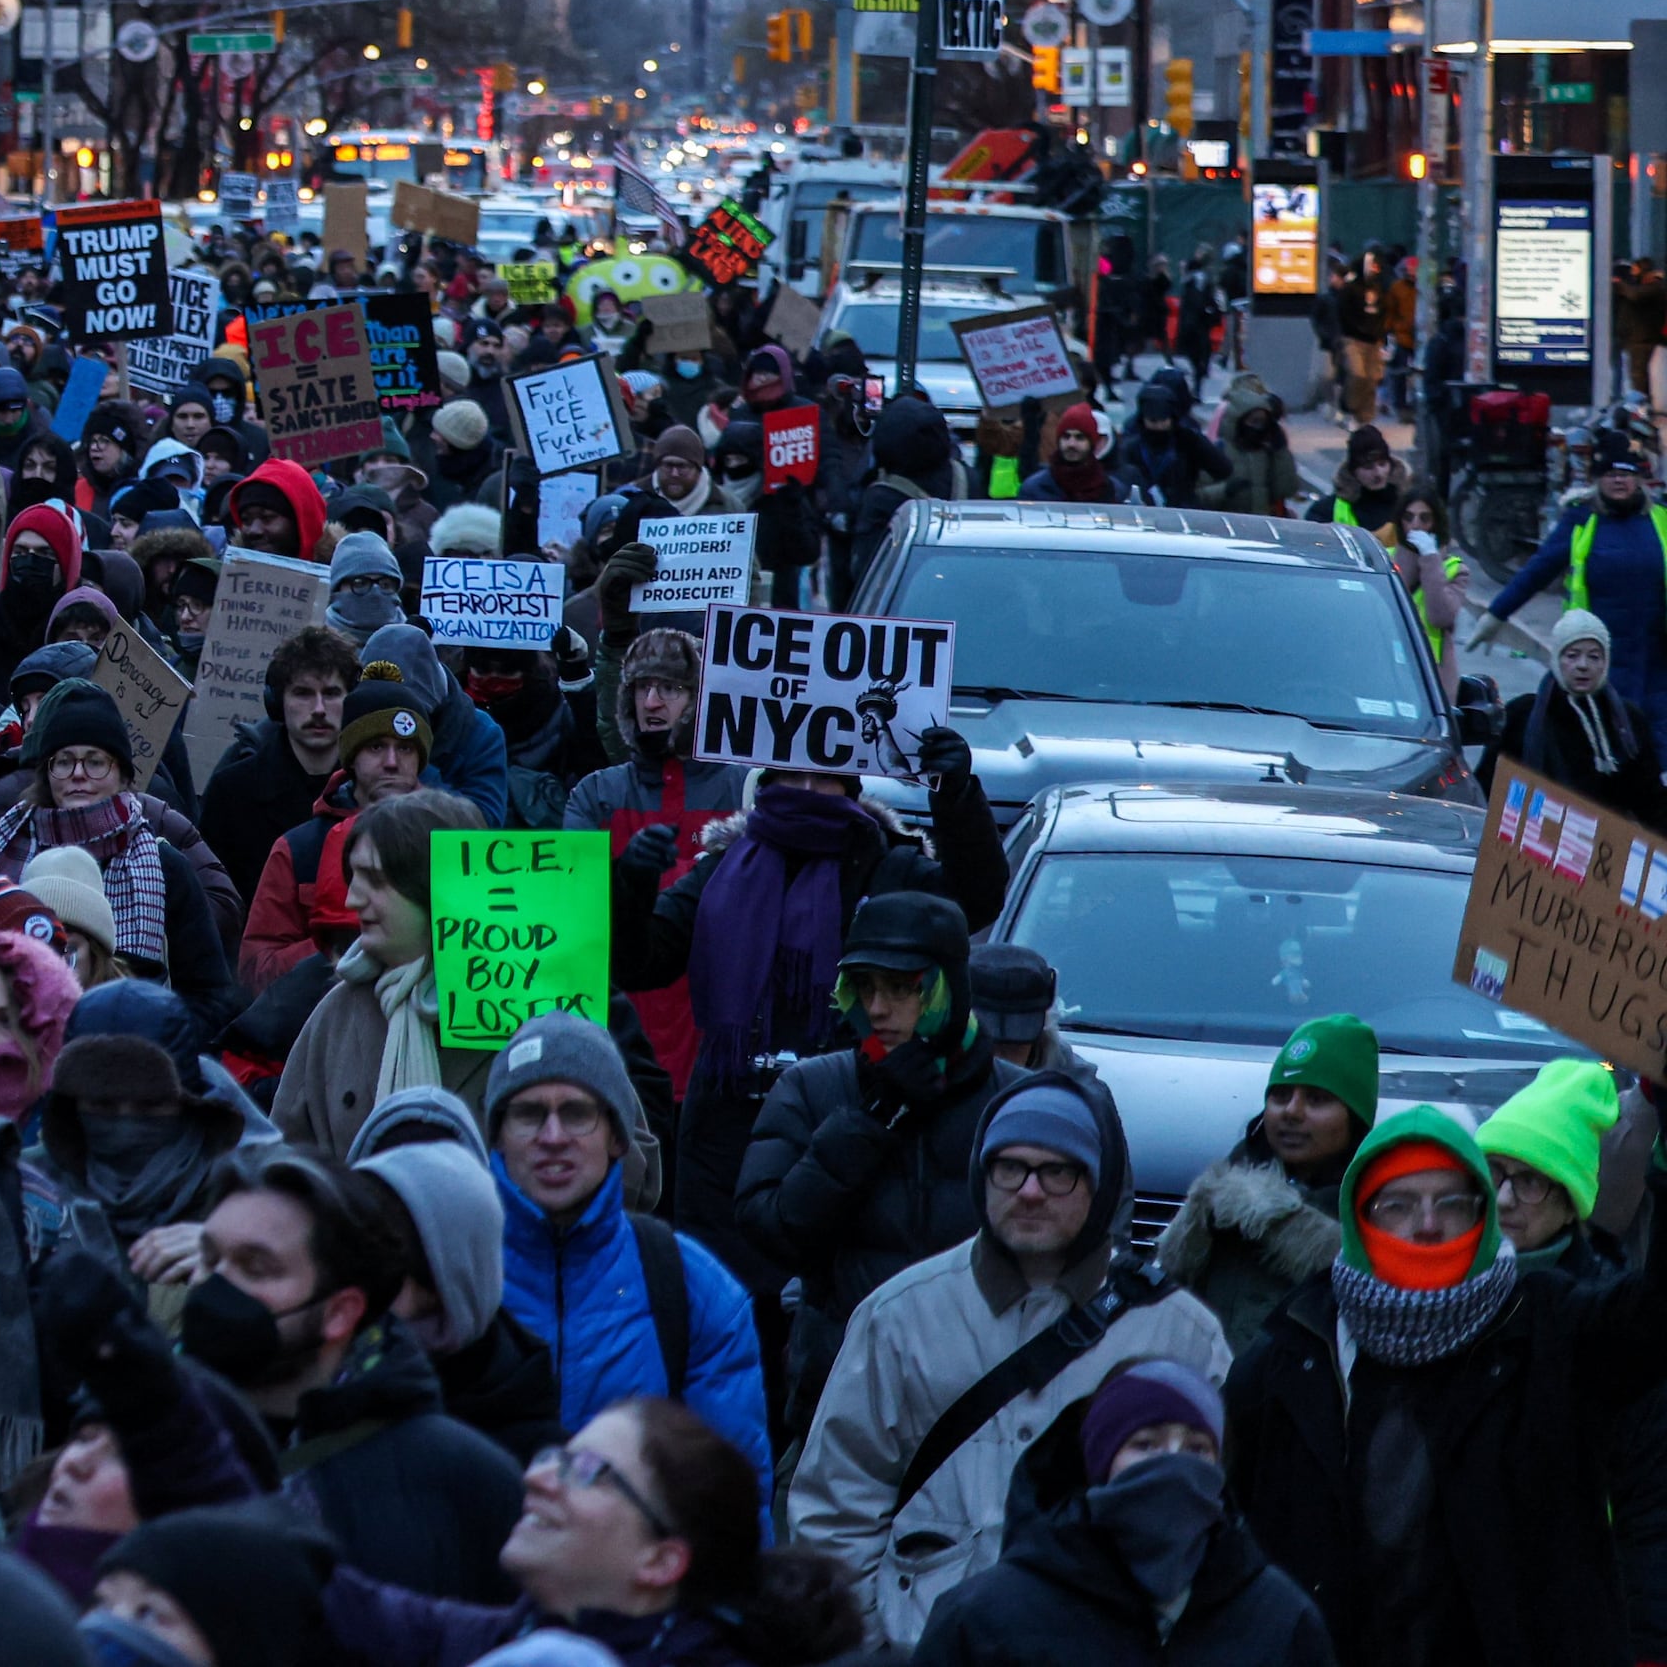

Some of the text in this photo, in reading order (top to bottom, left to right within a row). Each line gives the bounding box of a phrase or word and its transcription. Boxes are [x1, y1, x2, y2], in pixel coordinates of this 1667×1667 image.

[62, 222, 159, 257] TRUMP
[74, 252, 152, 282] MUST
[96, 279, 138, 307] GO
[84, 304, 157, 335] NOW!
[268, 374, 358, 414] STATE
[524, 375, 577, 411] Fuck
[546, 399, 588, 426] ICE
[536, 421, 589, 455] Fuck
[768, 424, 816, 446] HANDS
[560, 445, 609, 465] Trump
[768, 440, 817, 468] OFF!
[644, 519, 746, 539] NO MORE ICE
[653, 539, 732, 556] MURDERS!
[225, 571, 311, 603] TERRIBLE
[424, 559, 547, 593] ICE IS A
[647, 565, 743, 584] BOLISH AND
[423, 592, 560, 618] TERRORIST
[642, 585, 735, 603] PROSECUTE!
[711, 610, 948, 689] ICE OUT
[105, 631, 180, 715] Democracy
[770, 676, 807, 702] OF
[434, 917, 559, 953] PROUD
[465, 955, 540, 994] BOY
